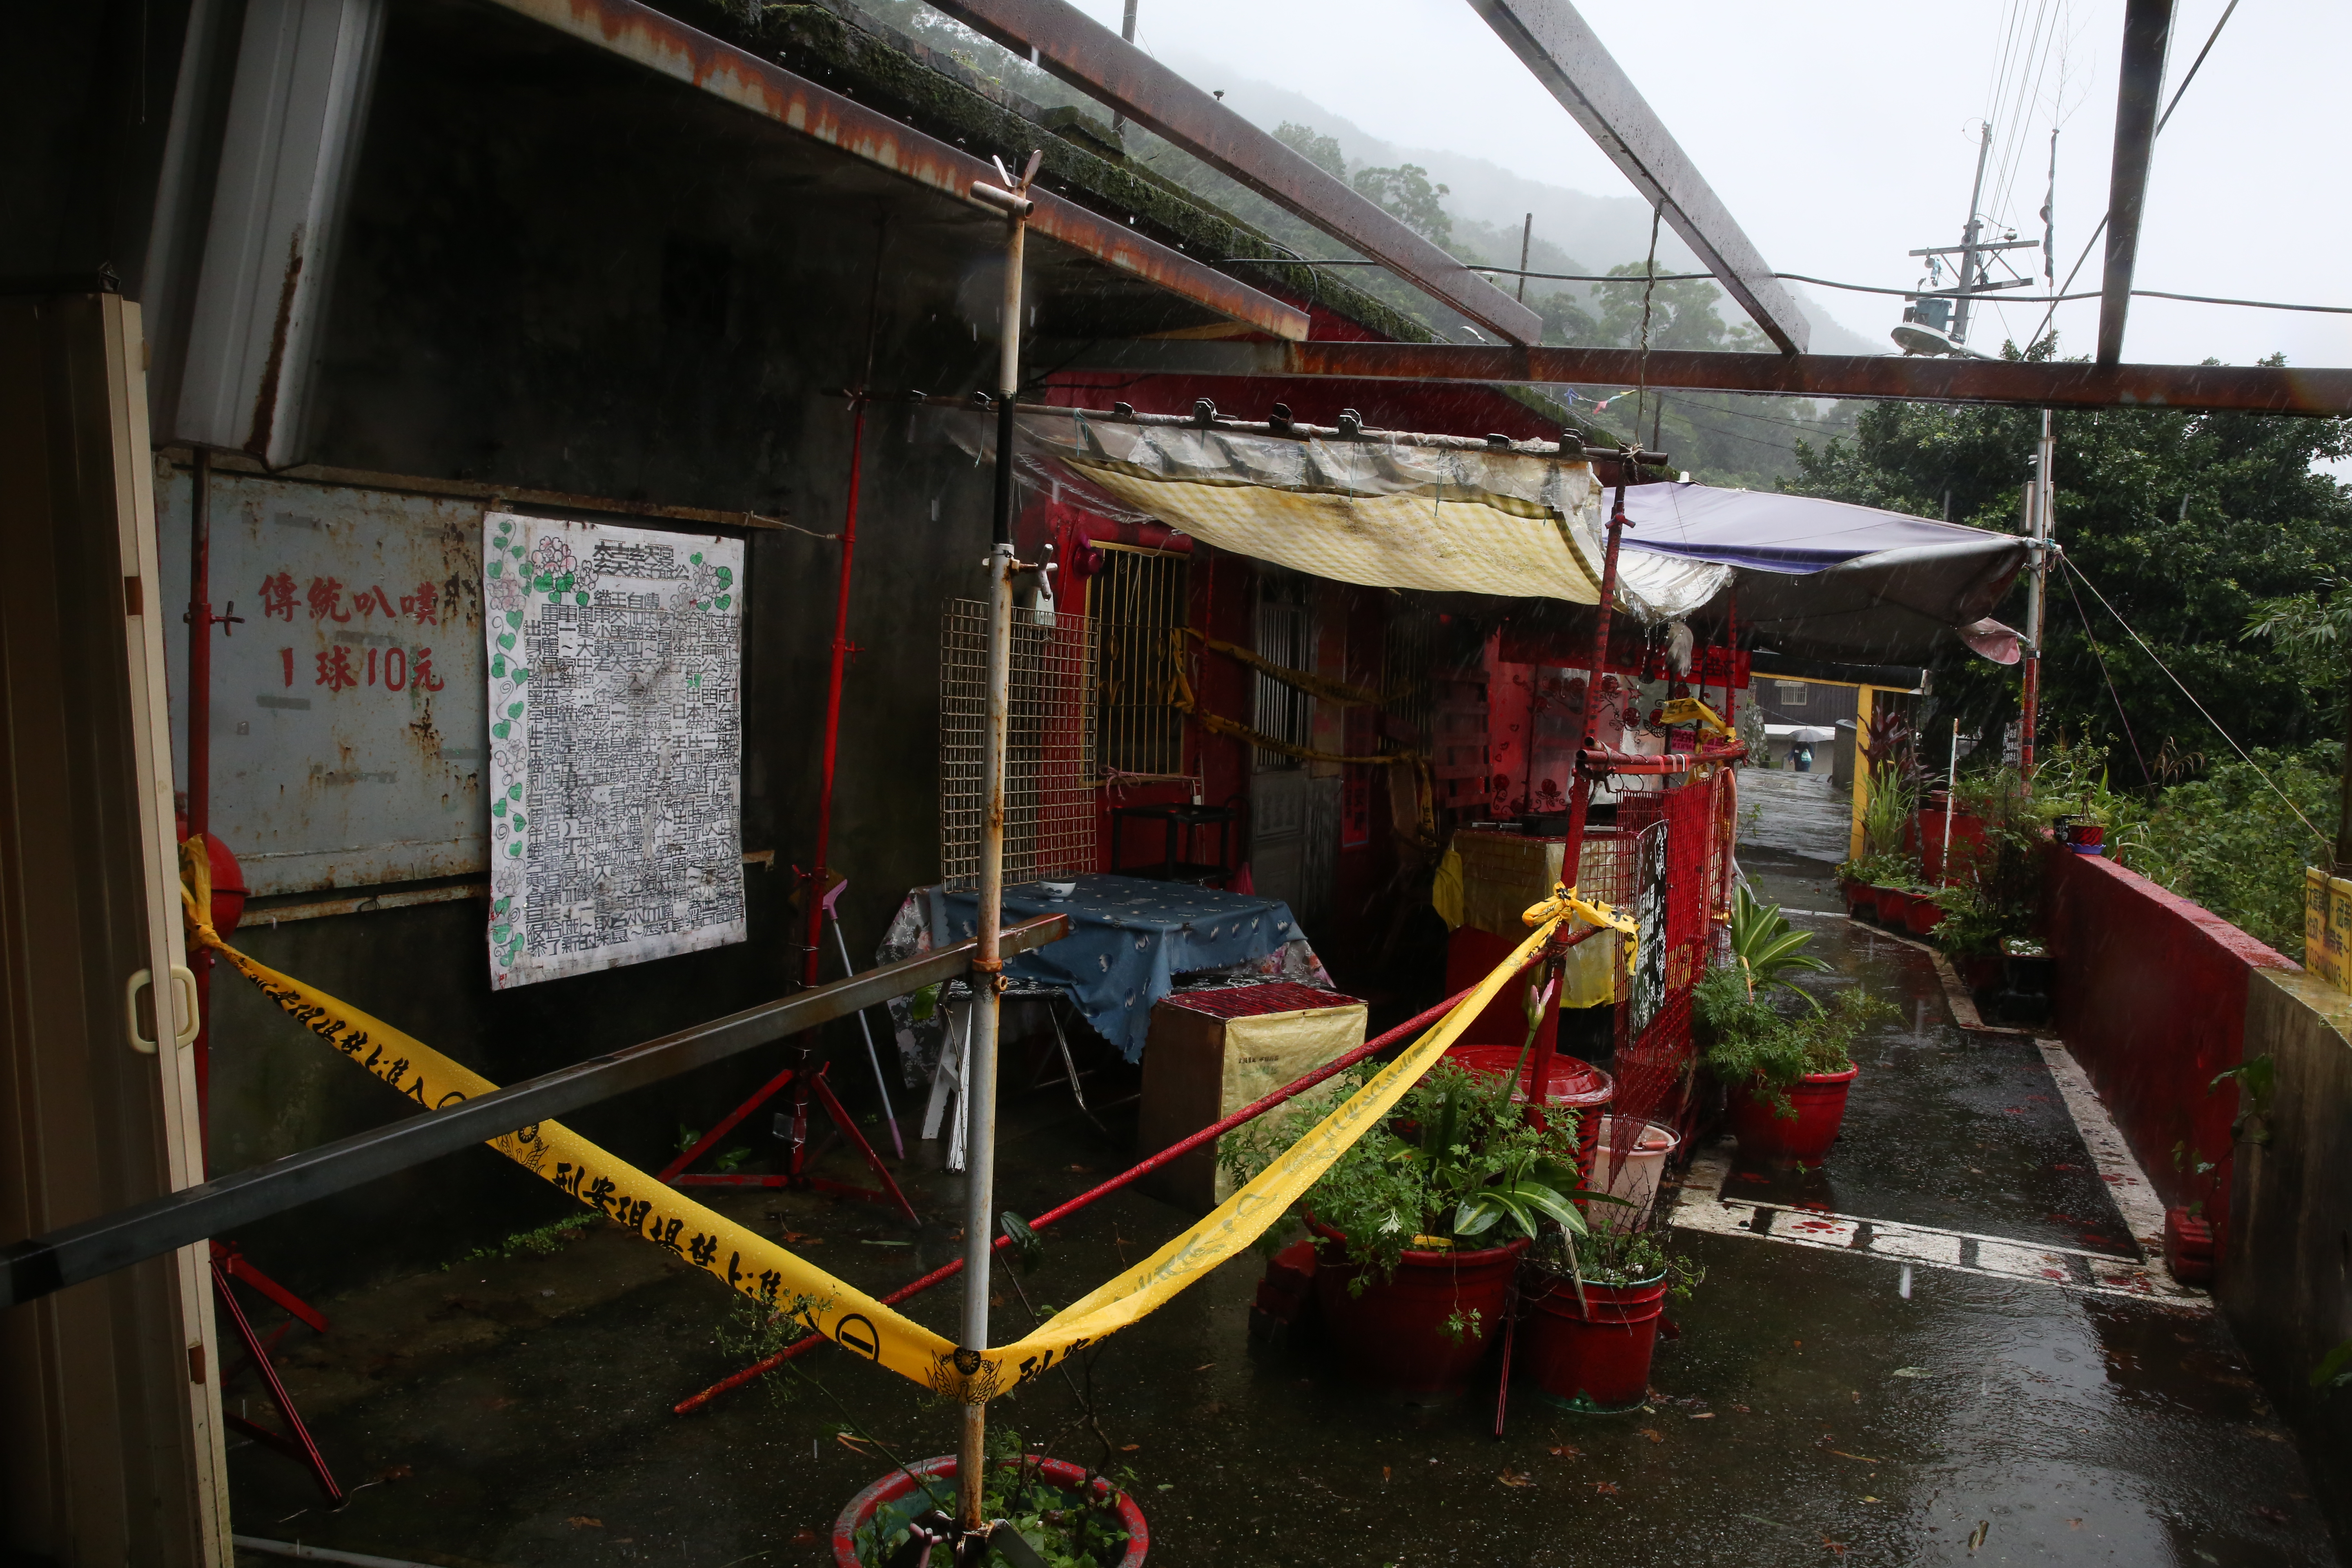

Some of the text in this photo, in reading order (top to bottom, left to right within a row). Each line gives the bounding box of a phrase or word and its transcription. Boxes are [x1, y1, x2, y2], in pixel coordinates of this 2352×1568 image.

[258, 572, 439, 626] 傳統叭噗
[281, 646, 445, 692] 1球10元
